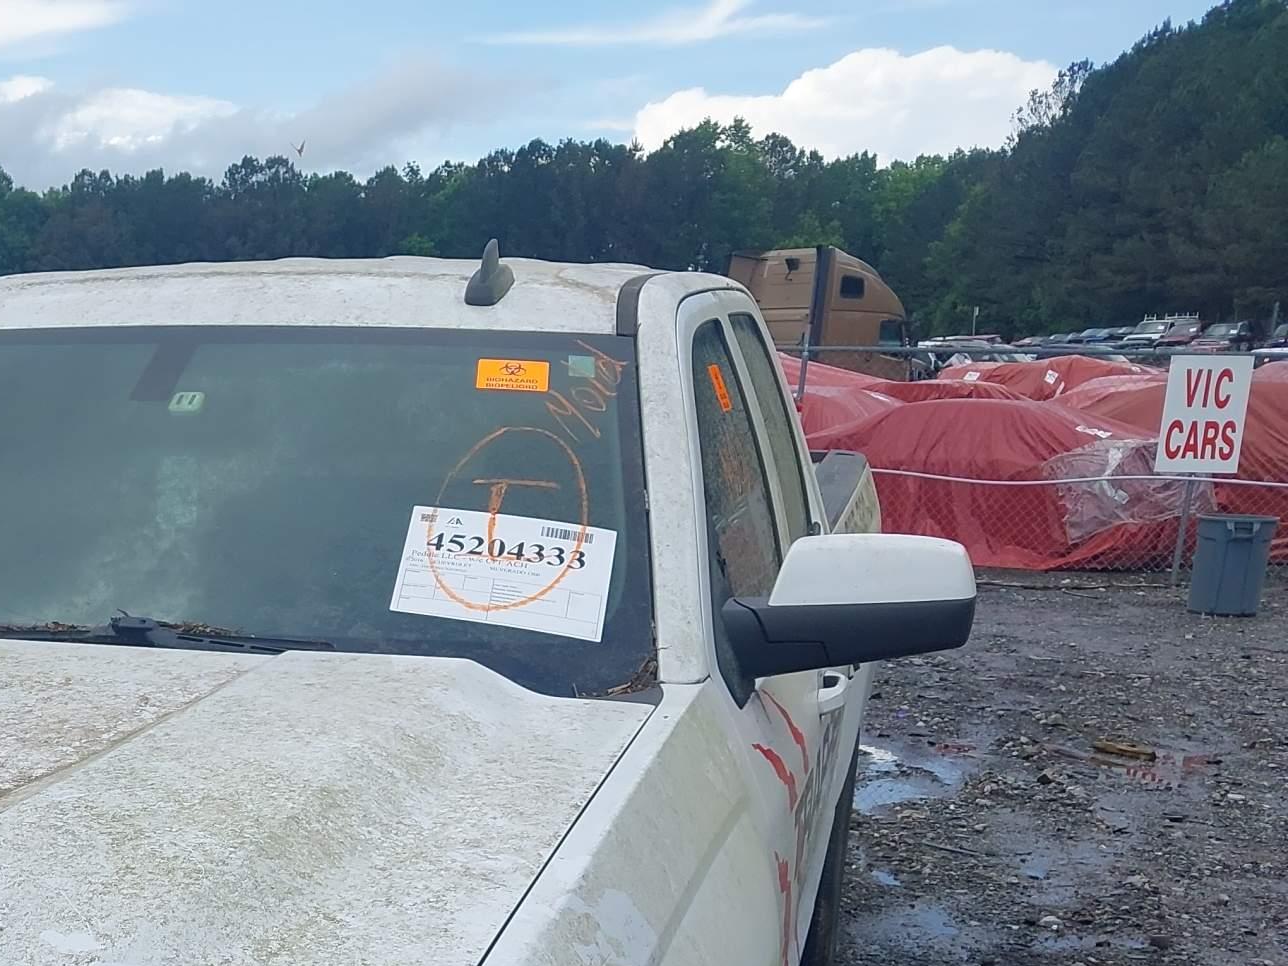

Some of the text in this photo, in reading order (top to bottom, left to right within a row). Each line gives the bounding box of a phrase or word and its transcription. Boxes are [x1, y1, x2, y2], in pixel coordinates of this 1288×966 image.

[1186, 368, 1233, 409] VIC
[1165, 419, 1237, 461] CARS
[427, 533, 586, 569] 45204333
